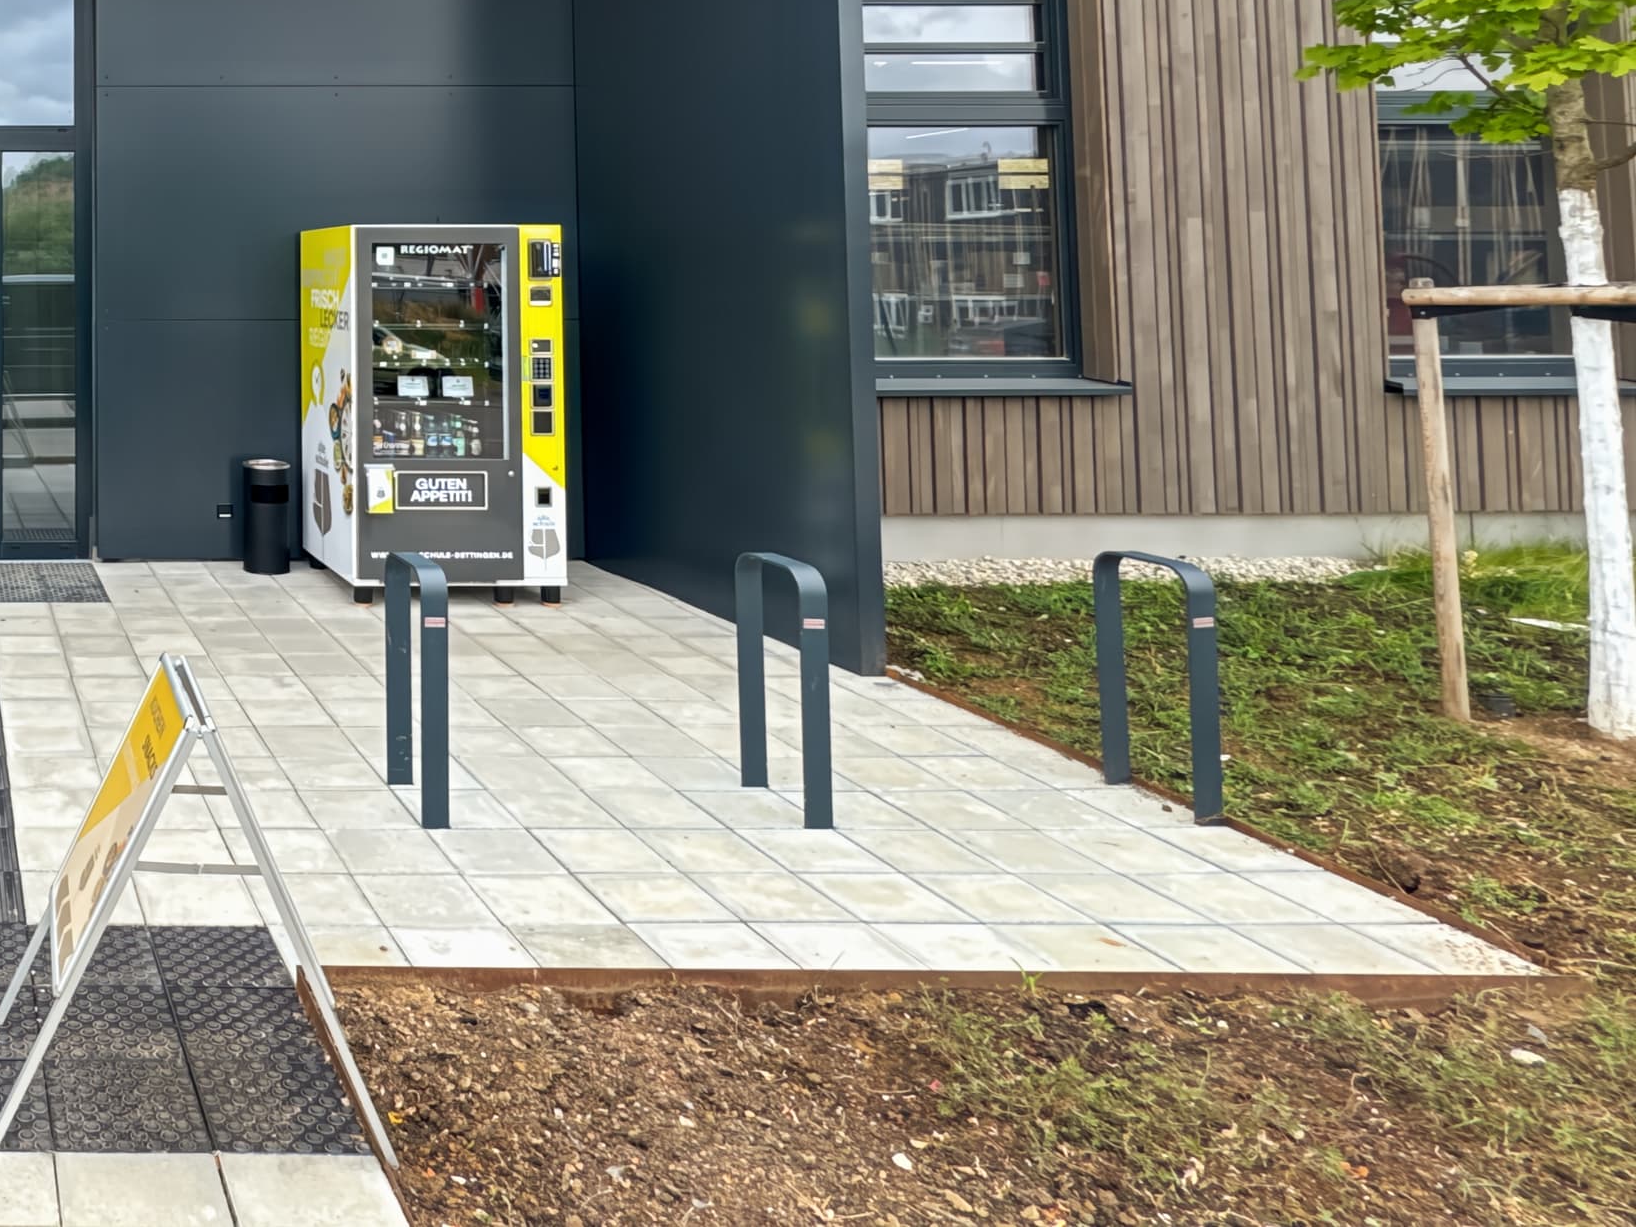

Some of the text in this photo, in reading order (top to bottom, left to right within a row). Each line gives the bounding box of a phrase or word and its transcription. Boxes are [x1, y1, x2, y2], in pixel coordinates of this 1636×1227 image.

[400, 245, 469, 255] REGIOMAT
[320, 309, 350, 331] LECKER
[415, 477, 467, 490] GUTEN
